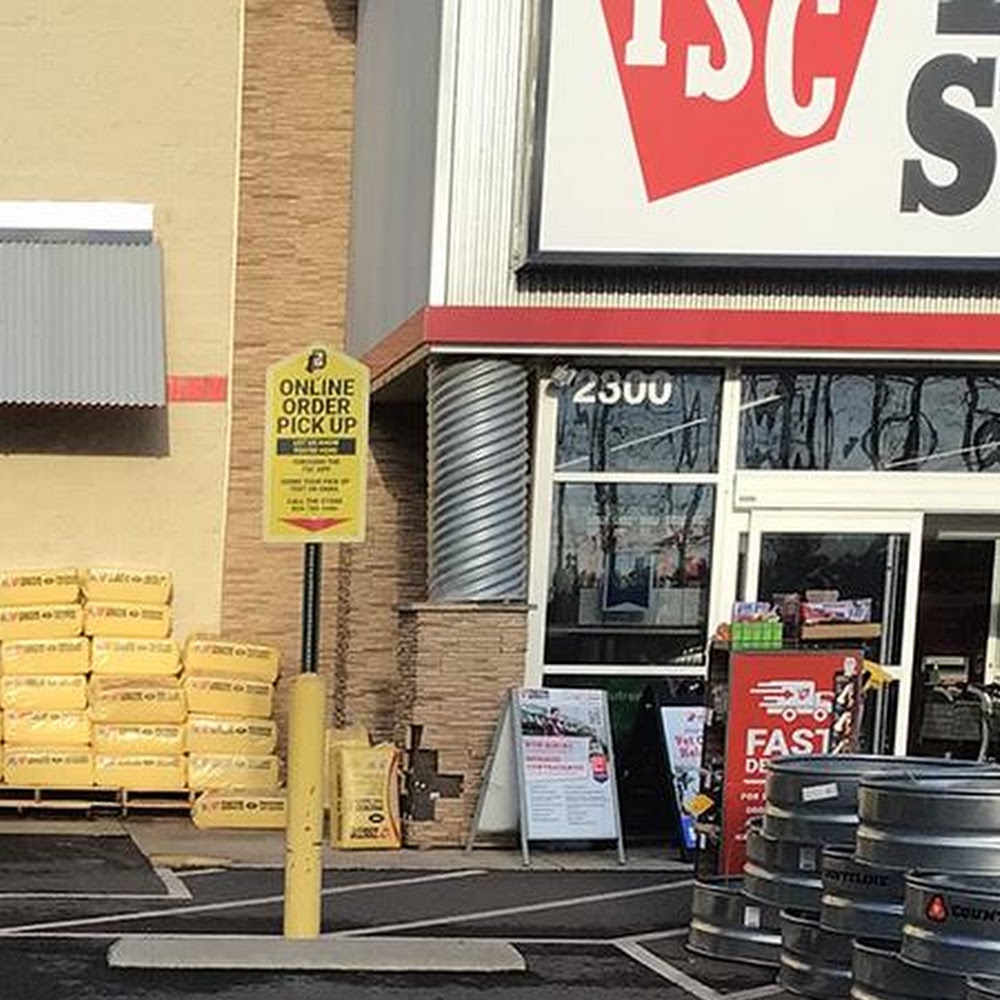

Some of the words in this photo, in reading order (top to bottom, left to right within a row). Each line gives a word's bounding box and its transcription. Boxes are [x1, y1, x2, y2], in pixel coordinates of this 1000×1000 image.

[279, 379, 355, 396] ONLINE
[573, 369, 672, 405] 2300
[282, 398, 350, 415] ORDER
[277, 417, 325, 434] PICK
[330, 418, 357, 434] UP
